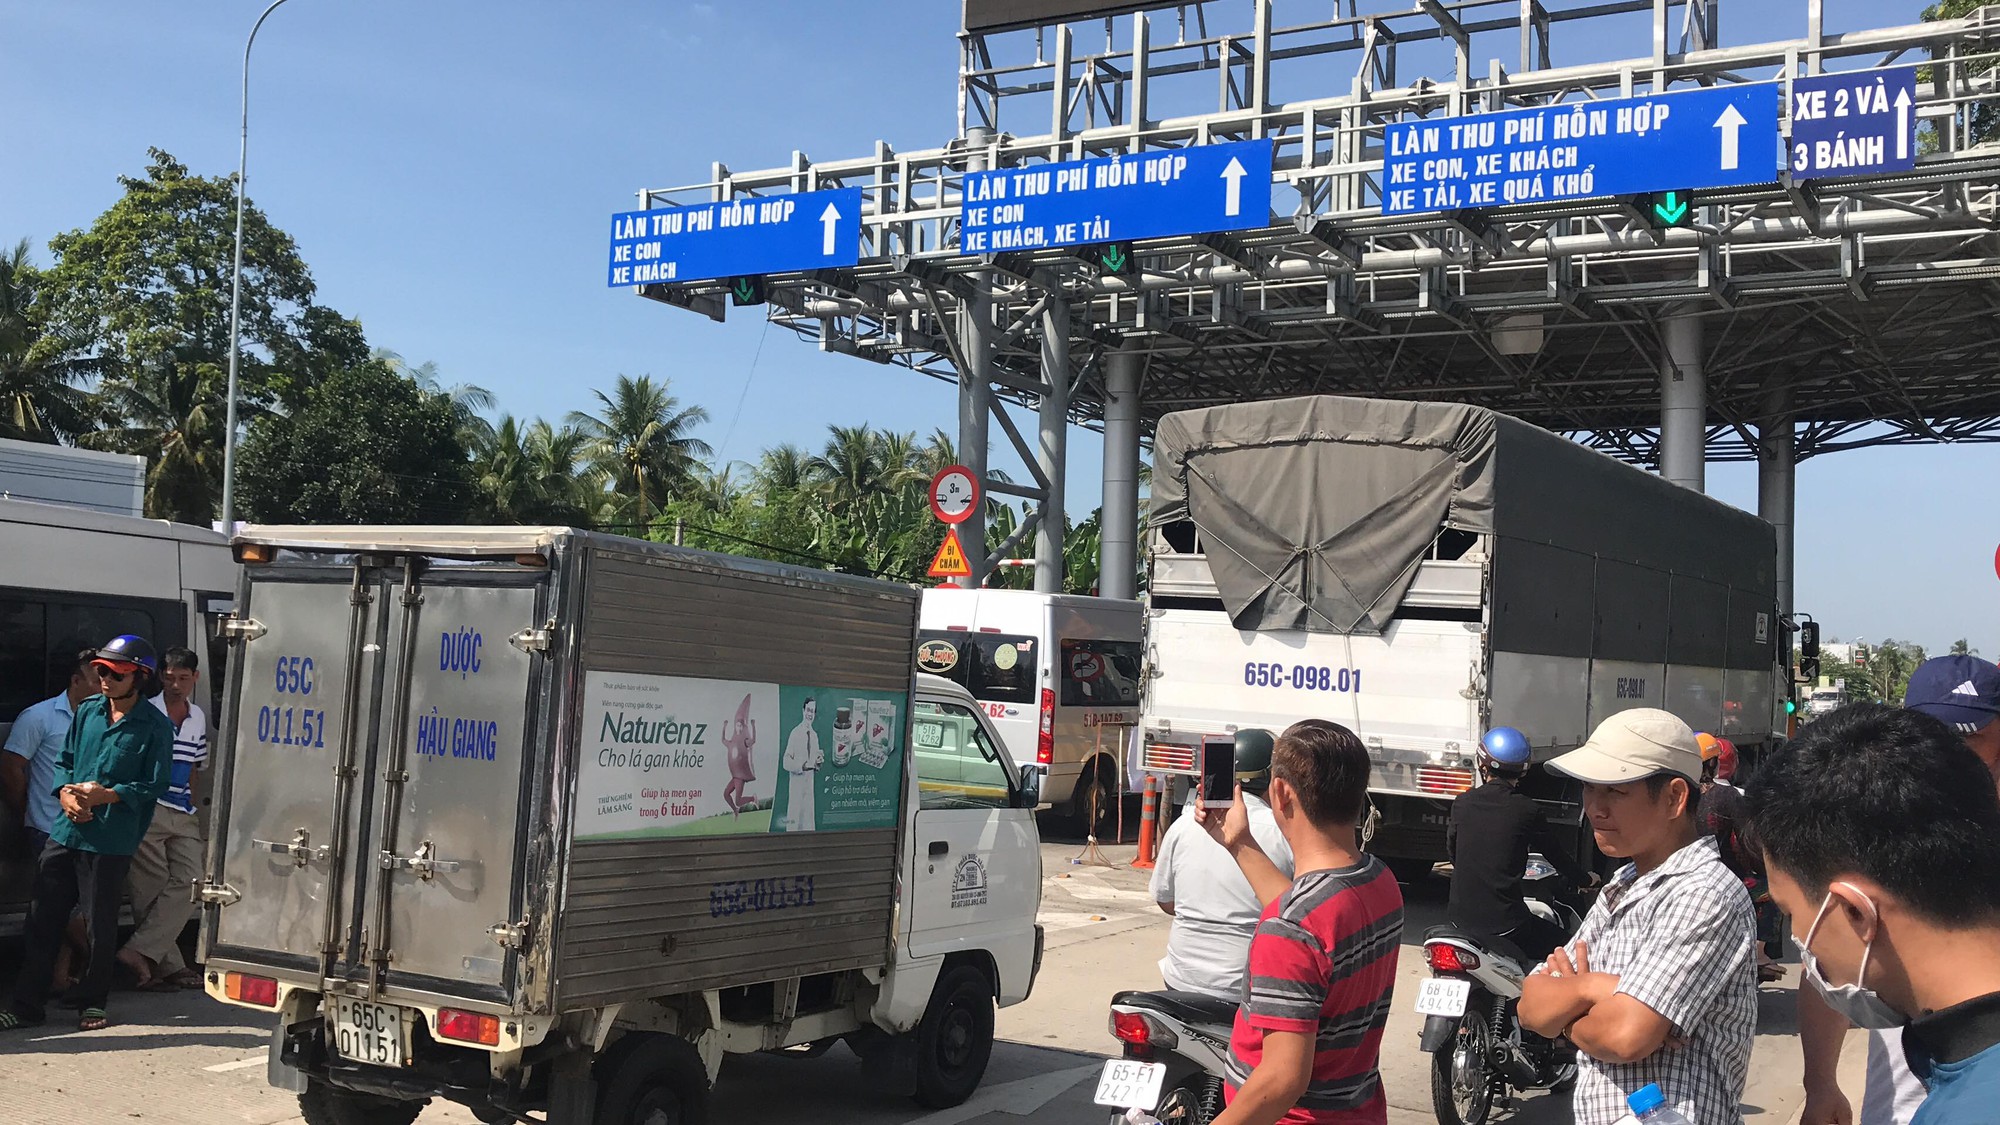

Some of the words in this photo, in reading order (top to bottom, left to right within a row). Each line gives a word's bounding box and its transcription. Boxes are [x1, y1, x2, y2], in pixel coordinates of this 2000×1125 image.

[1794, 90, 1826, 121] XE
[1834, 88, 1849, 117] 2
[1855, 76, 1889, 115] VÀ
[1391, 127, 1440, 156] LÀN
[1448, 121, 1495, 150] THU
[1504, 111, 1544, 146] PHÍ
[1553, 105, 1607, 140] HỖN
[1616, 104, 1670, 141] HỢP
[1390, 162, 1416, 184] XE
[1423, 157, 1468, 184] CON,
[1475, 154, 1502, 175] XE
[1508, 143, 1578, 173] KHÁCH
[1794, 142, 1808, 171] 3
[1815, 131, 1884, 170] BÁNH
[967, 175, 1006, 202] LÀN
[1013, 174, 1049, 195] THU
[1056, 163, 1089, 193] PHÍ
[1095, 156, 1138, 188] HỖN
[1144, 154, 1187, 186] HỢP
[1389, 190, 1415, 211] XE
[1423, 181, 1462, 210] TẢI,
[1468, 181, 1496, 203] XE
[1503, 172, 1544, 201] QUÁ
[1552, 164, 1596, 195] KHỔ
[615, 215, 647, 240] LÀN
[652, 213, 683, 236] THU
[687, 205, 714, 232] PHÍ
[720, 199, 755, 228] HỖN
[760, 200, 795, 226] HỢP
[967, 208, 987, 227] XE
[992, 204, 1024, 224] CON
[966, 232, 987, 251] XE
[992, 225, 1049, 248] KHÁCH,
[1054, 223, 1076, 242] XE
[1082, 215, 1110, 239] TẢI
[614, 246, 631, 262] XE
[635, 242, 661, 260] CON
[613, 267, 629, 284] XE
[634, 261, 676, 282] KHÁCH
[947, 545, 955, 556] ĐI
[440, 625, 482, 680] DƯỢC
[276, 656, 313, 695] 65C
[1244, 662, 1361, 693] 65C-098.01
[258, 705, 324, 748] 011.51
[416, 706, 448, 762] HẬU
[452, 718, 497, 761] GIANG
[600, 712, 707, 745] Naturenz
[922, 725, 936, 735] 51B
[598, 748, 626, 768] Cho
[629, 748, 641, 768] lá
[644, 753, 670, 773] gan
[673, 750, 705, 768] khỏe
[640, 808, 659, 818] trong
[661, 801, 668, 816] 6
[670, 800, 695, 816] tuần
[660, 788, 669, 801] hạ
[671, 790, 688, 798] men
[689, 789, 702, 800] gan
[352, 1002, 385, 1033] 65C
[341, 1029, 396, 1063] 011.51
[1182, 1027, 1226, 1050] BLADE
